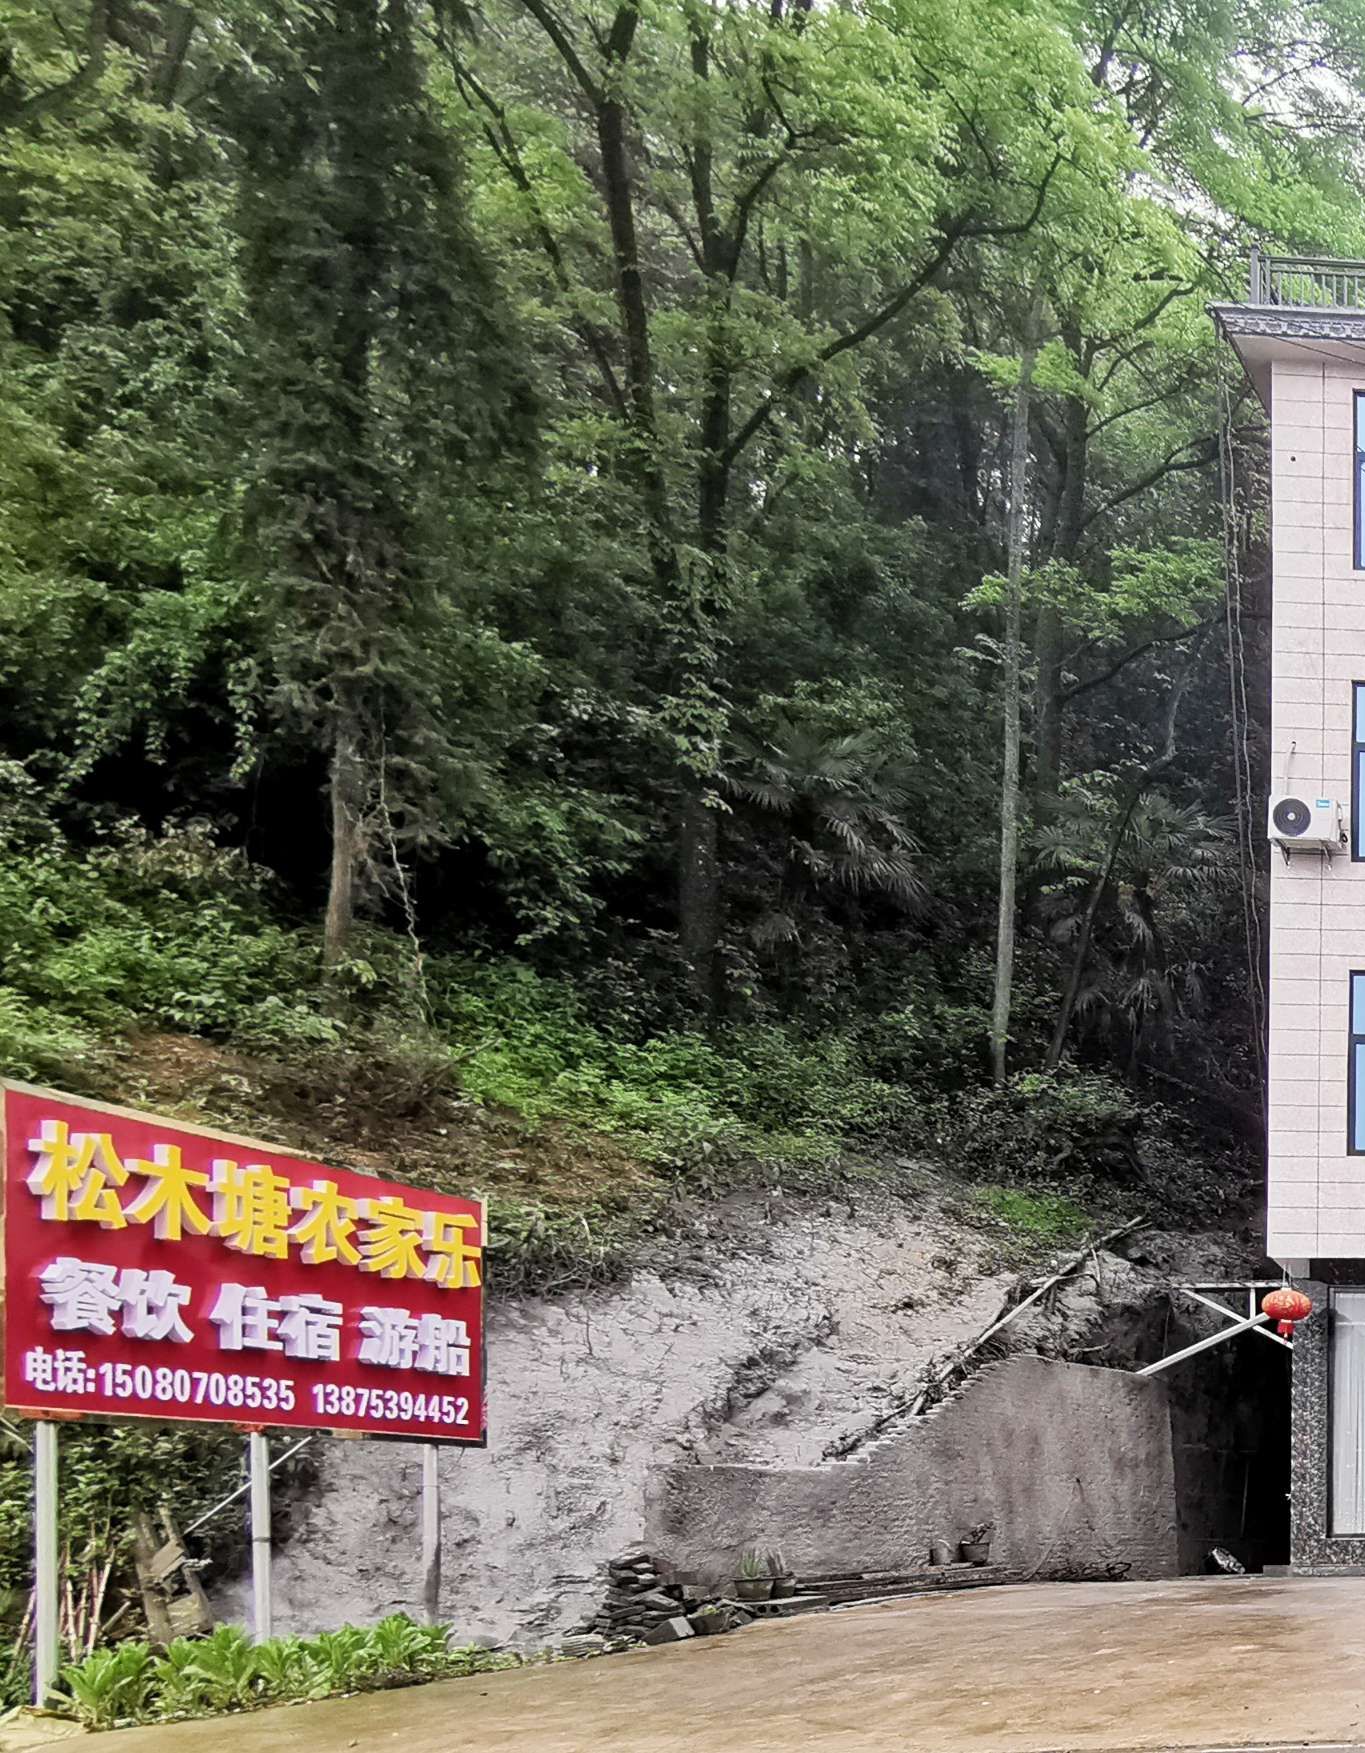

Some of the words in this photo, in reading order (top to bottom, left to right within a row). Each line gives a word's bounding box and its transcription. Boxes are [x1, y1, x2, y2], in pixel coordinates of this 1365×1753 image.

[27, 1119, 482, 1288] 松木塘农家乐
[40, 1258, 194, 1343] 餐饮
[210, 1283, 343, 1361] 住宿
[359, 1306, 470, 1376] 游船
[312, 1384, 468, 1425] 13875394452
